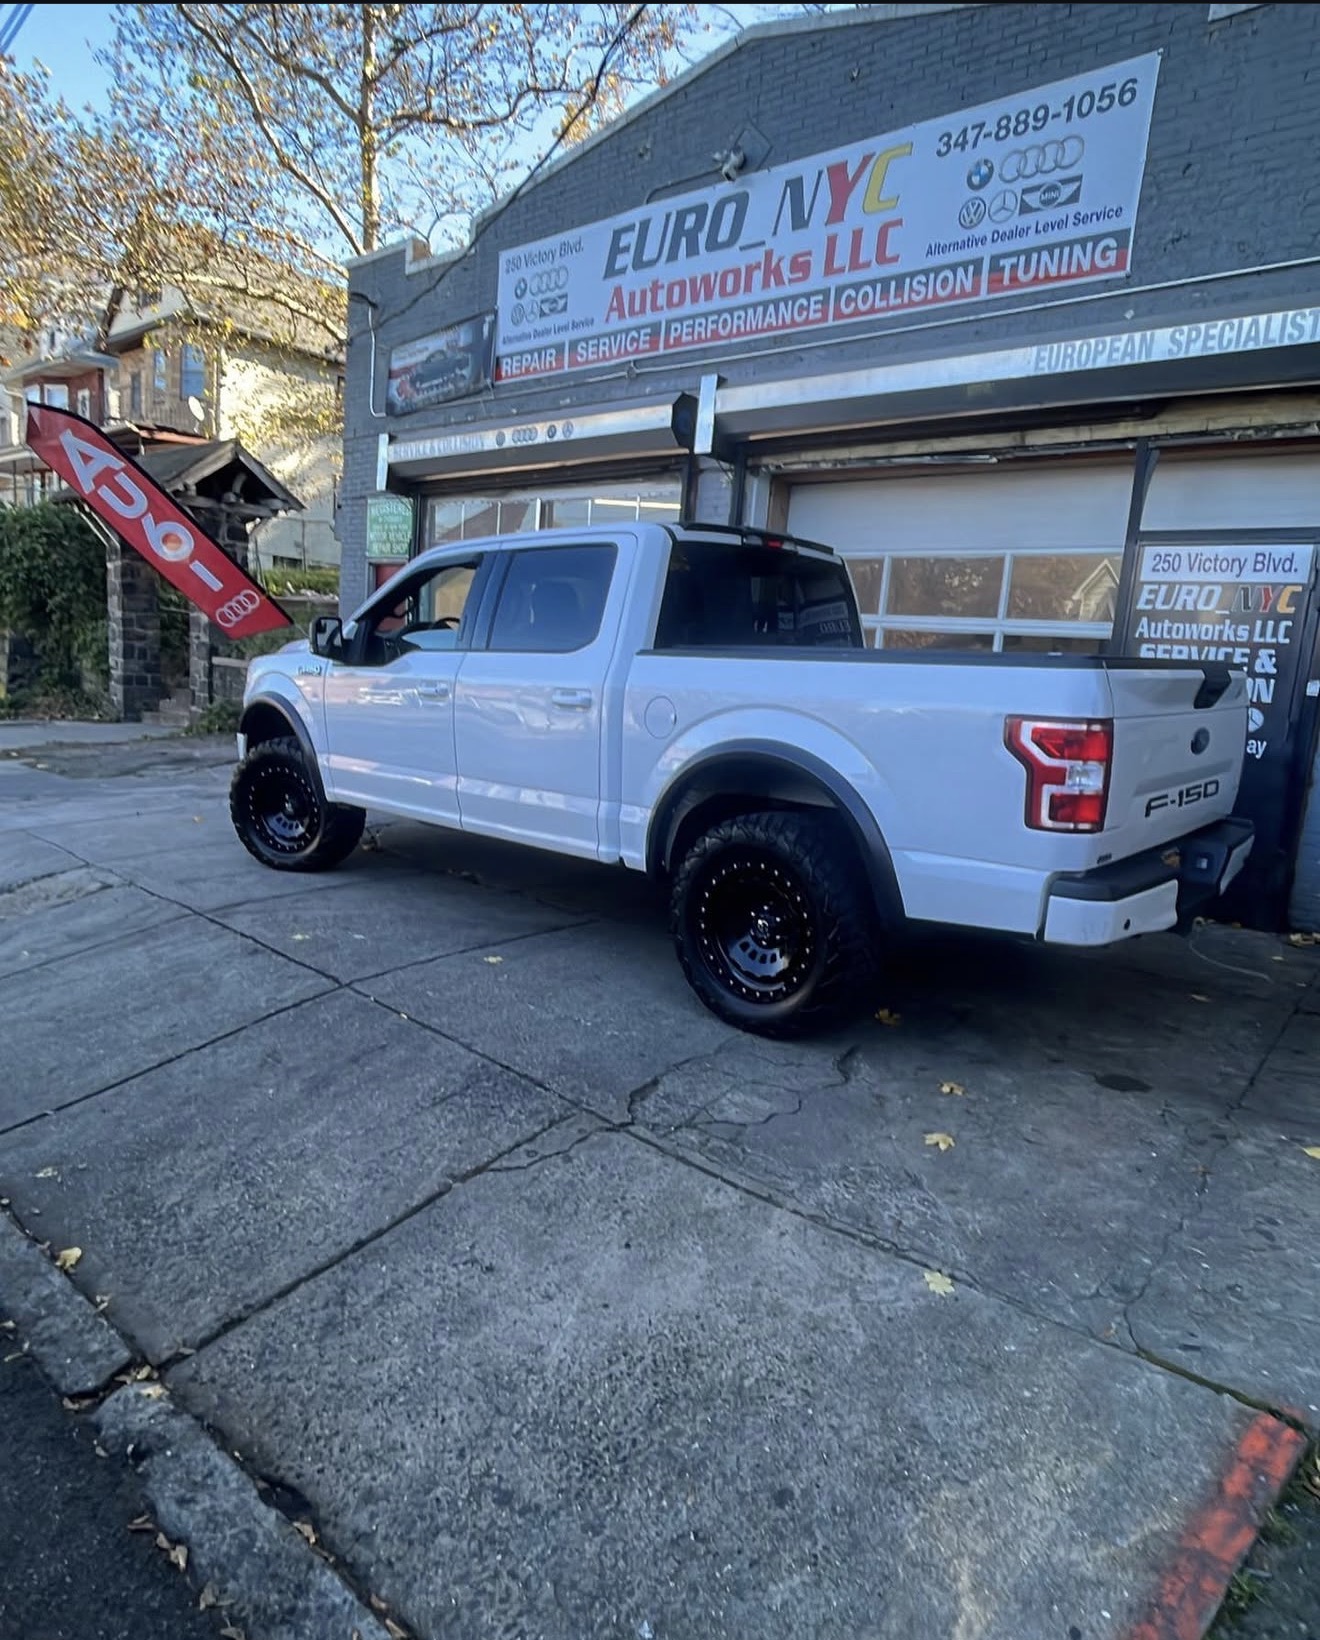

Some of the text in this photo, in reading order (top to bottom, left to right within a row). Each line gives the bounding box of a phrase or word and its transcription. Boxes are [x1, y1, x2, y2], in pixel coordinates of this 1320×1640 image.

[936, 78, 1138, 158] 347-889-1056
[926, 205, 1124, 258] Alternative Dealer Level Service
[524, 248, 557, 268] Victory
[559, 236, 585, 257] Blvd.
[604, 217, 904, 324] Autoworks LLC
[501, 237, 1119, 378] REPAIR SERVICE PERFORMANCE COLLISION TUNING
[1034, 331, 1155, 373] EUROPEAN
[1152, 552, 1299, 578] 250 Victory Blvd.
[1135, 617, 1293, 644] Autoworks LLC
[1255, 648, 1278, 675] &
[1145, 779, 1220, 818] F-150
